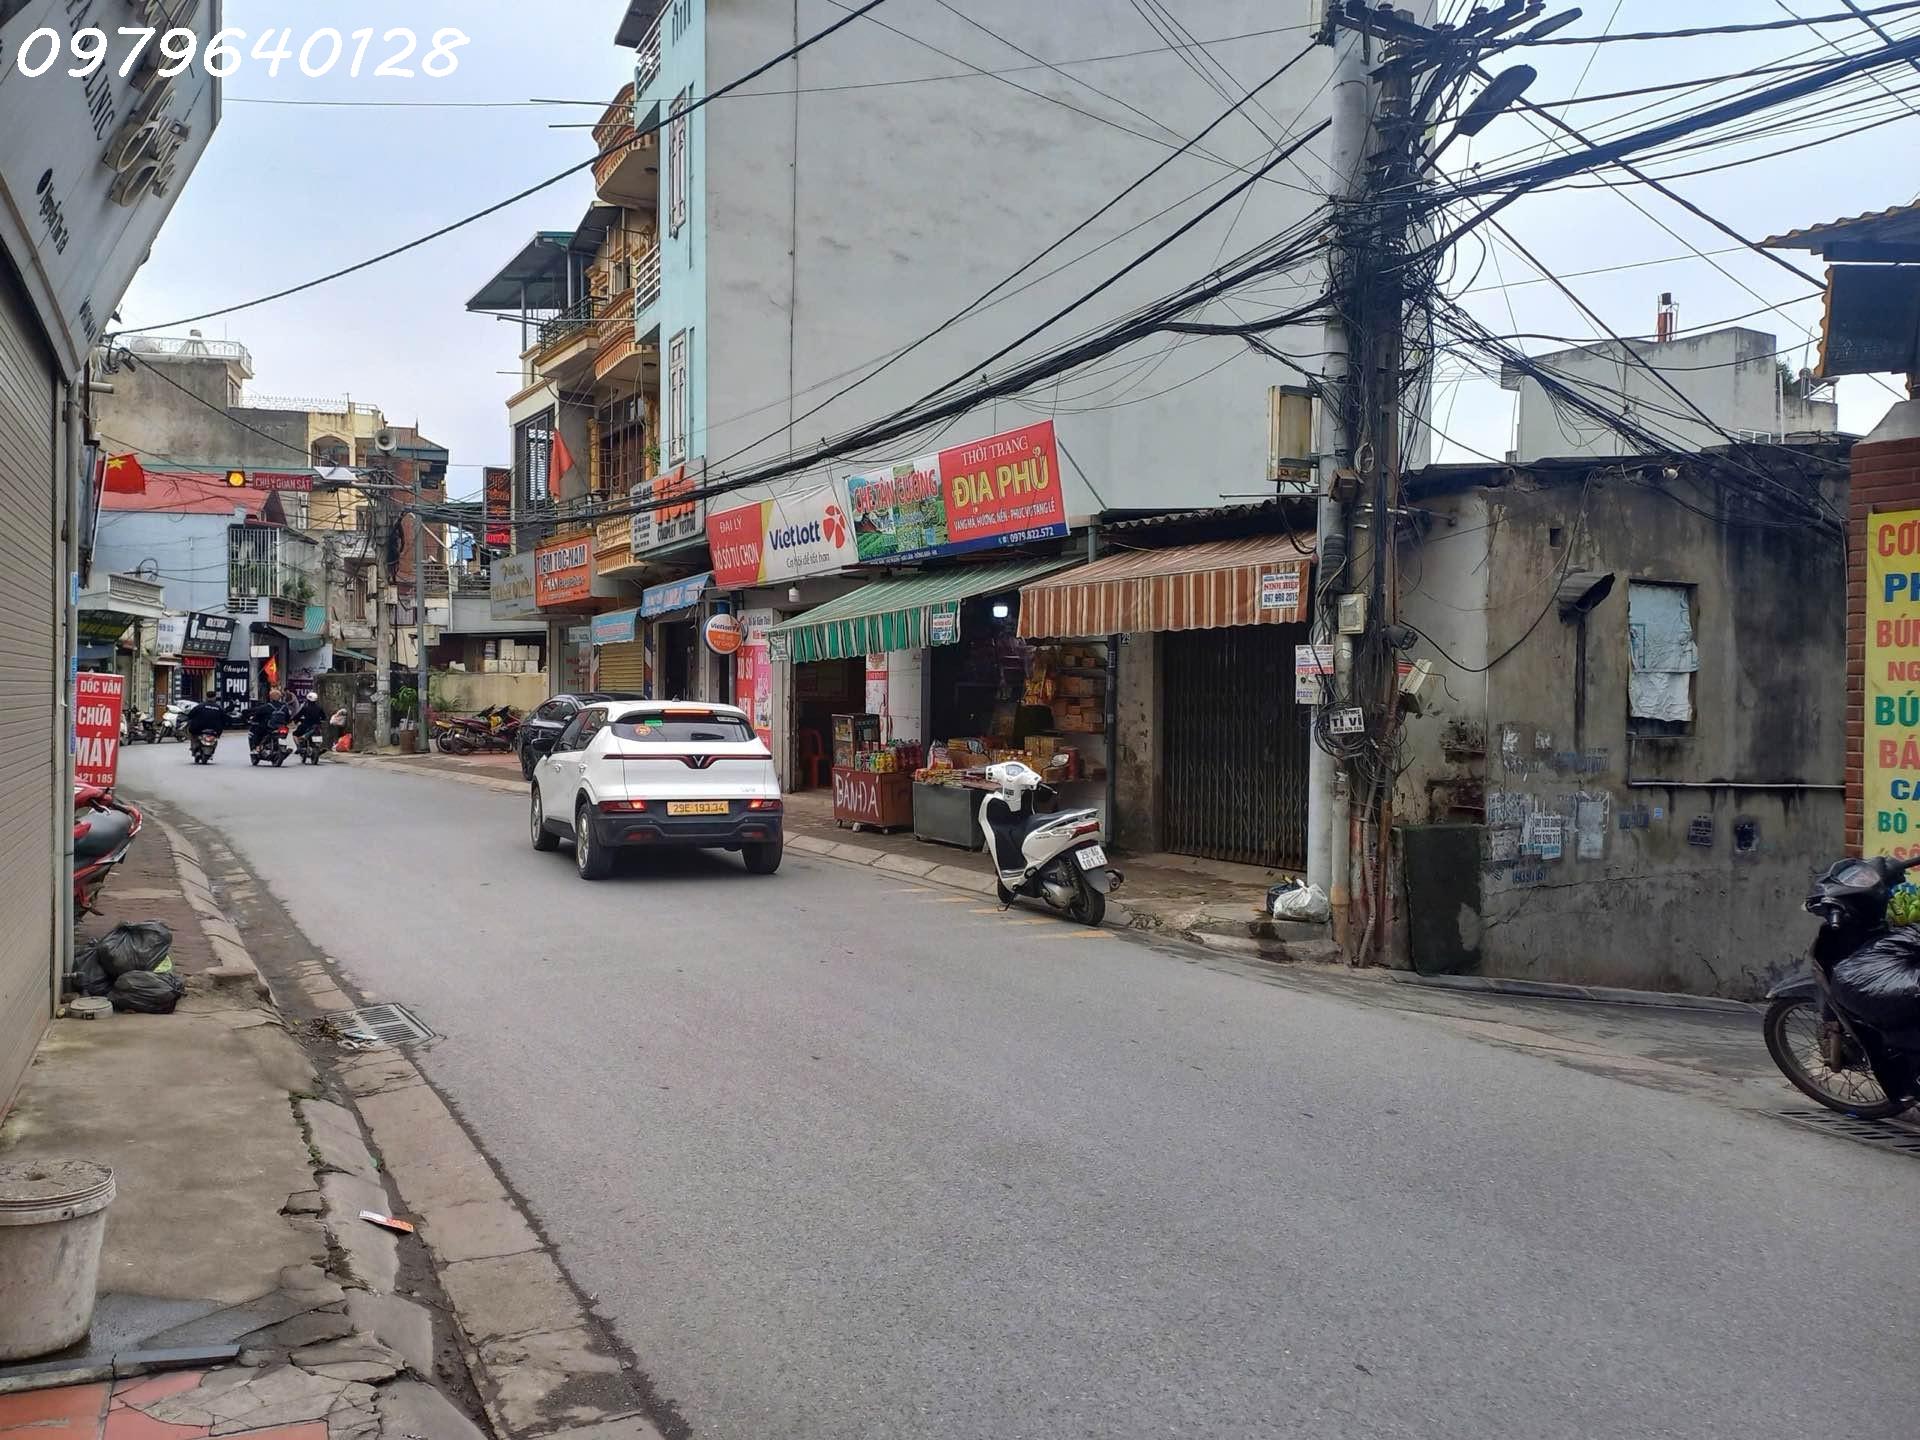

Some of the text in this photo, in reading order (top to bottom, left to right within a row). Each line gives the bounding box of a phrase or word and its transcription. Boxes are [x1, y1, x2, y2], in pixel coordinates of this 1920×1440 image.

[961, 435, 1029, 467] THỜI TRANG
[952, 446, 1049, 514] ĐỊA PHỦ
[769, 520, 821, 551] Vietlott
[1010, 526, 1055, 543] 0979.822.572
[226, 678, 247, 696] PHỤ
[78, 703, 112, 727] CHỮA
[76, 731, 116, 768] MÁY
